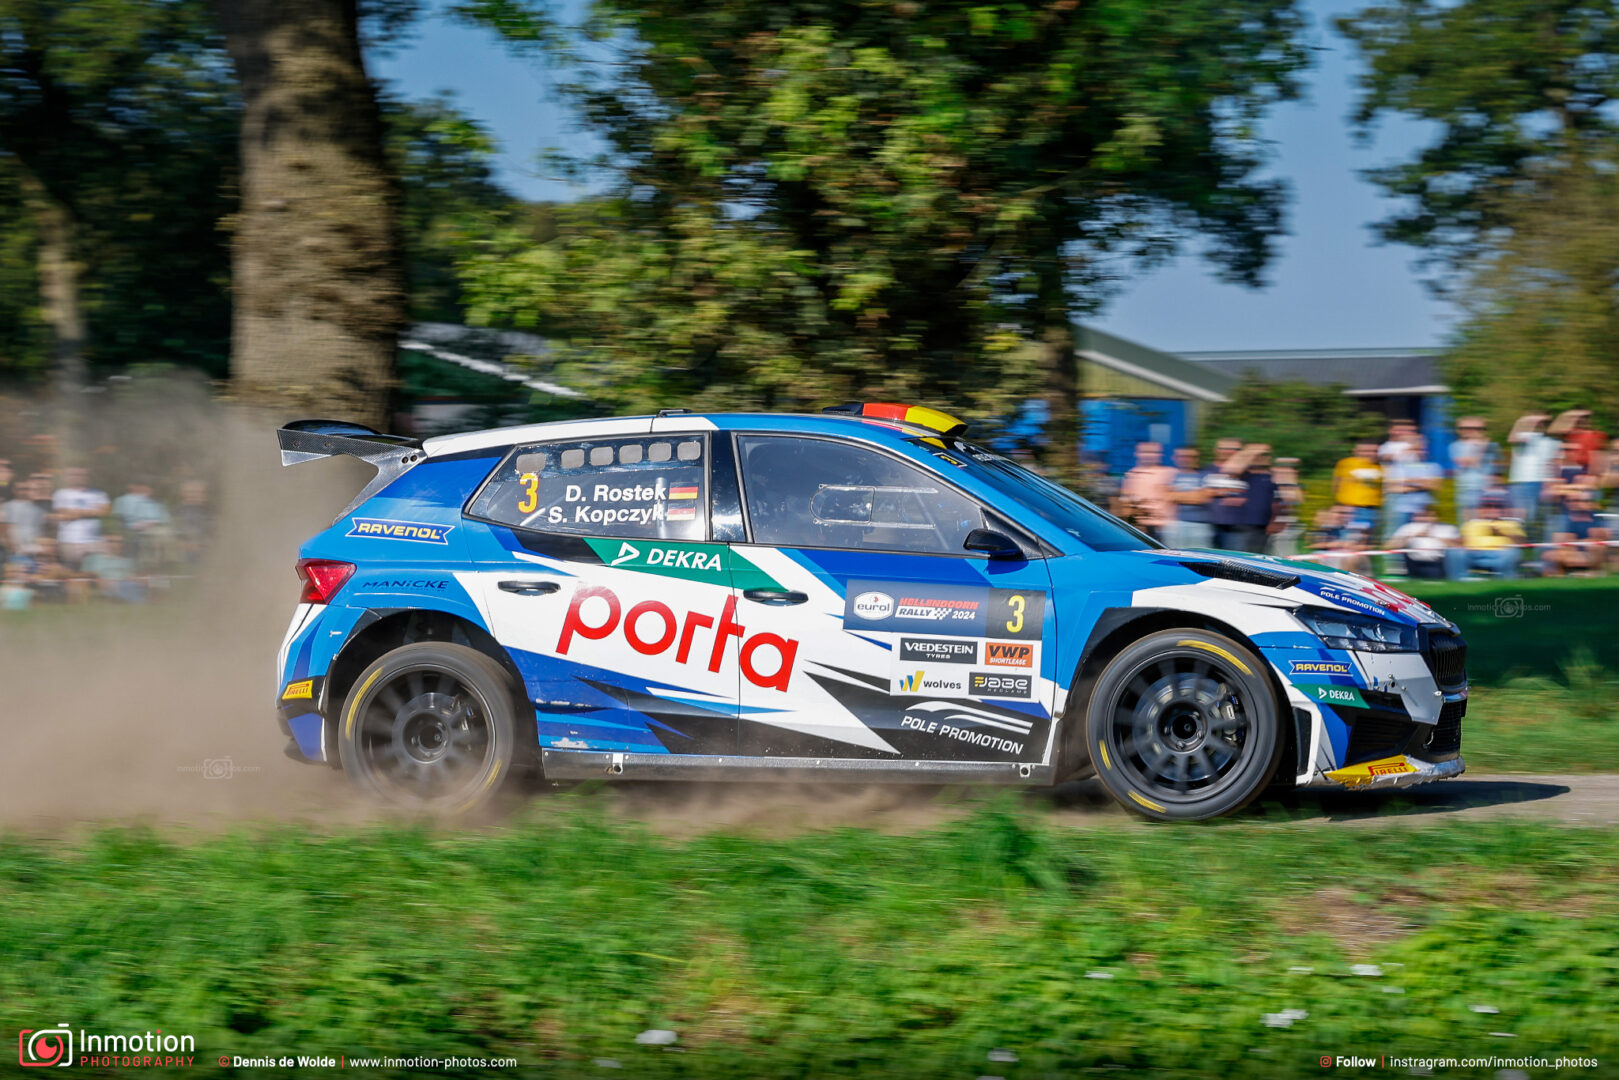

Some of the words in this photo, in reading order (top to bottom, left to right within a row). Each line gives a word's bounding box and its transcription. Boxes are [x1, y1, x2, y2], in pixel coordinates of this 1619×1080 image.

[518, 473, 539, 513] 3
[565, 485, 586, 502] D.
[593, 484, 667, 502] Rostek
[547, 506, 568, 524] S.
[575, 504, 665, 526] Kopczyk
[358, 523, 441, 540] RAVENOL
[646, 548, 722, 571] DEKRA
[857, 603, 890, 612] eurol
[899, 597, 979, 610] HELLENDOORN
[1320, 590, 1340, 600] POLE
[1341, 597, 1386, 616] PROMOTION
[898, 607, 932, 617] RALLY
[952, 611, 976, 620] 2024
[1006, 595, 1026, 633] 3
[556, 586, 800, 692] porta
[904, 642, 974, 655] VREDESTEIN
[989, 645, 1030, 658] VWP
[1295, 663, 1349, 673] RAVENOL
[923, 680, 962, 690] wolves
[1329, 690, 1355, 701] DEKRA
[901, 715, 939, 734] POLE
[939, 726, 1024, 755] PROMOTION
